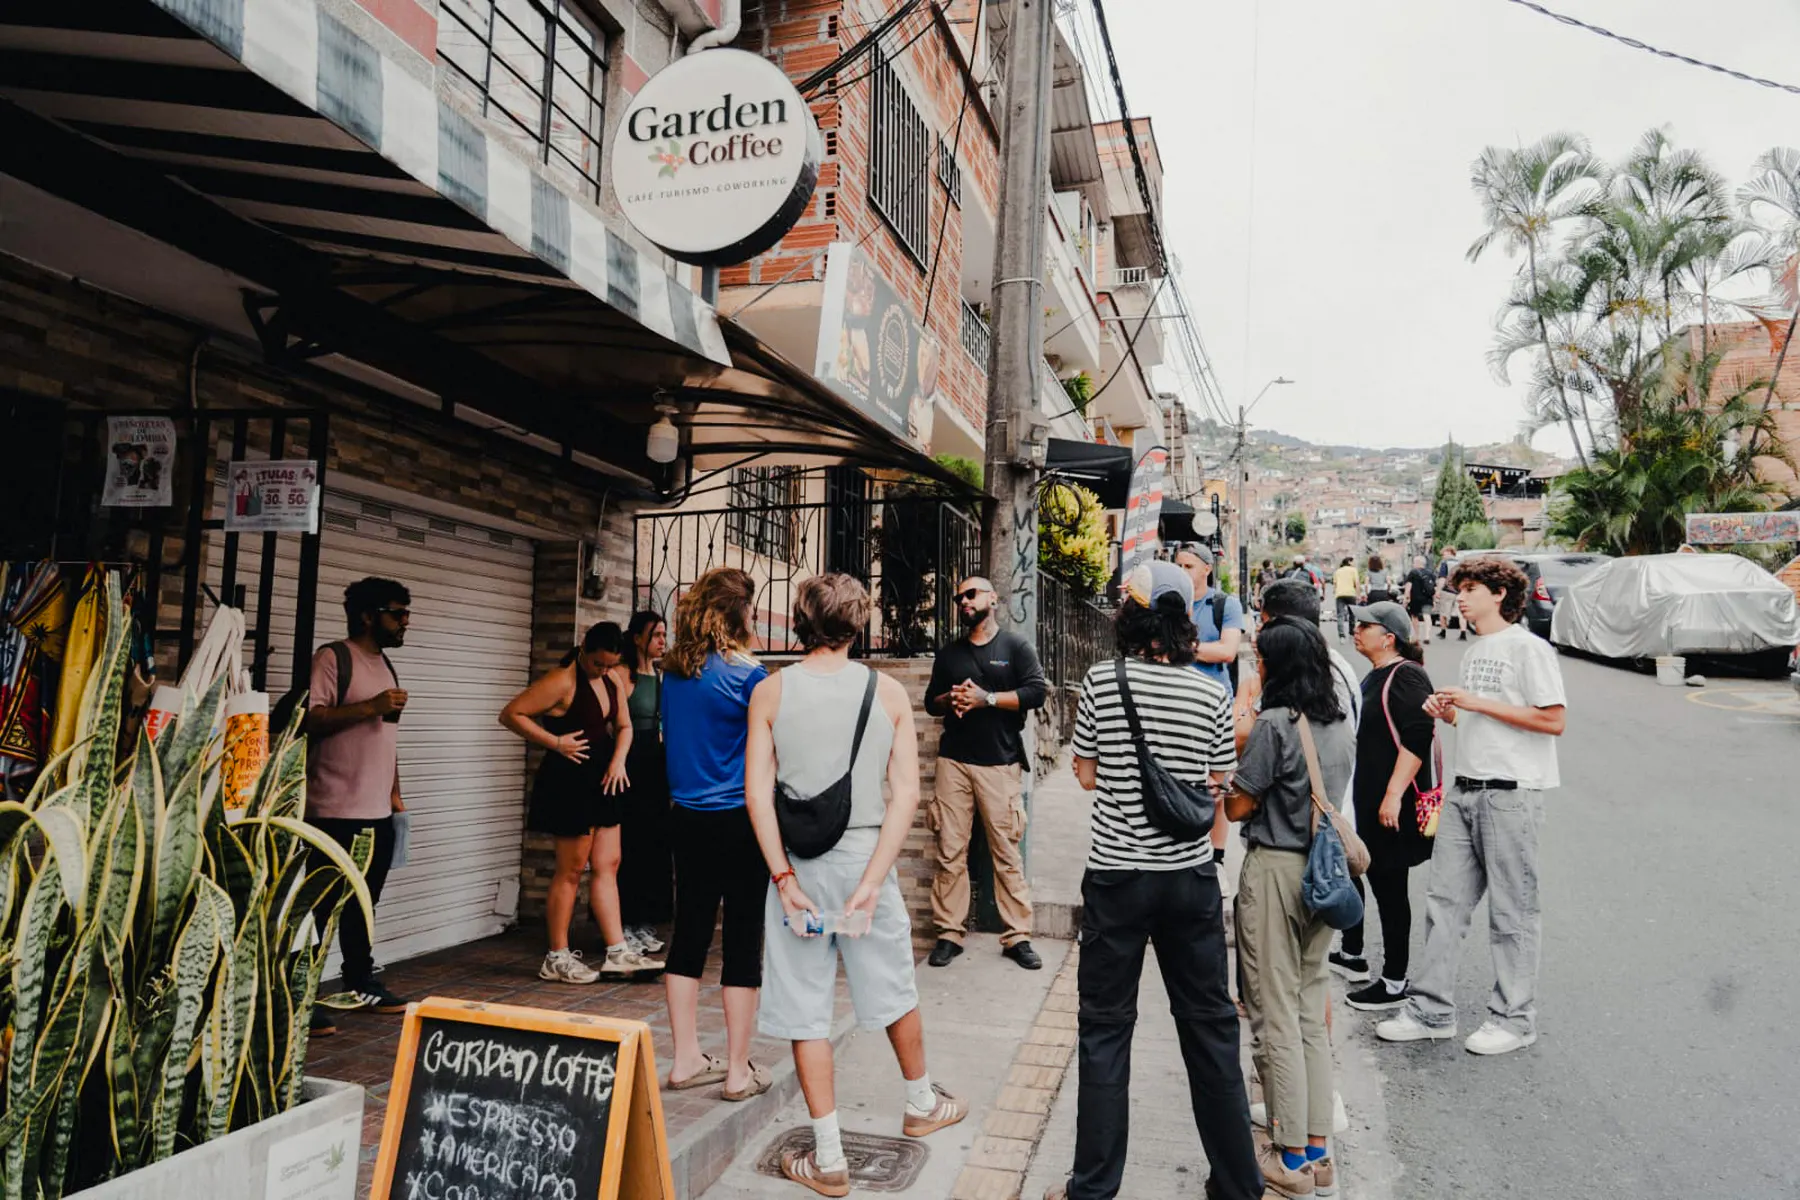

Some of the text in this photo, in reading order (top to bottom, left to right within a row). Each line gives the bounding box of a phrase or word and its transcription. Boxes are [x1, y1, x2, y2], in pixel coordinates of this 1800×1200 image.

[628, 93, 788, 142] Garden
[688, 133, 783, 166] Coffee
[660, 186, 710, 199] TURISMO
[716, 177, 788, 193] COWORKING
